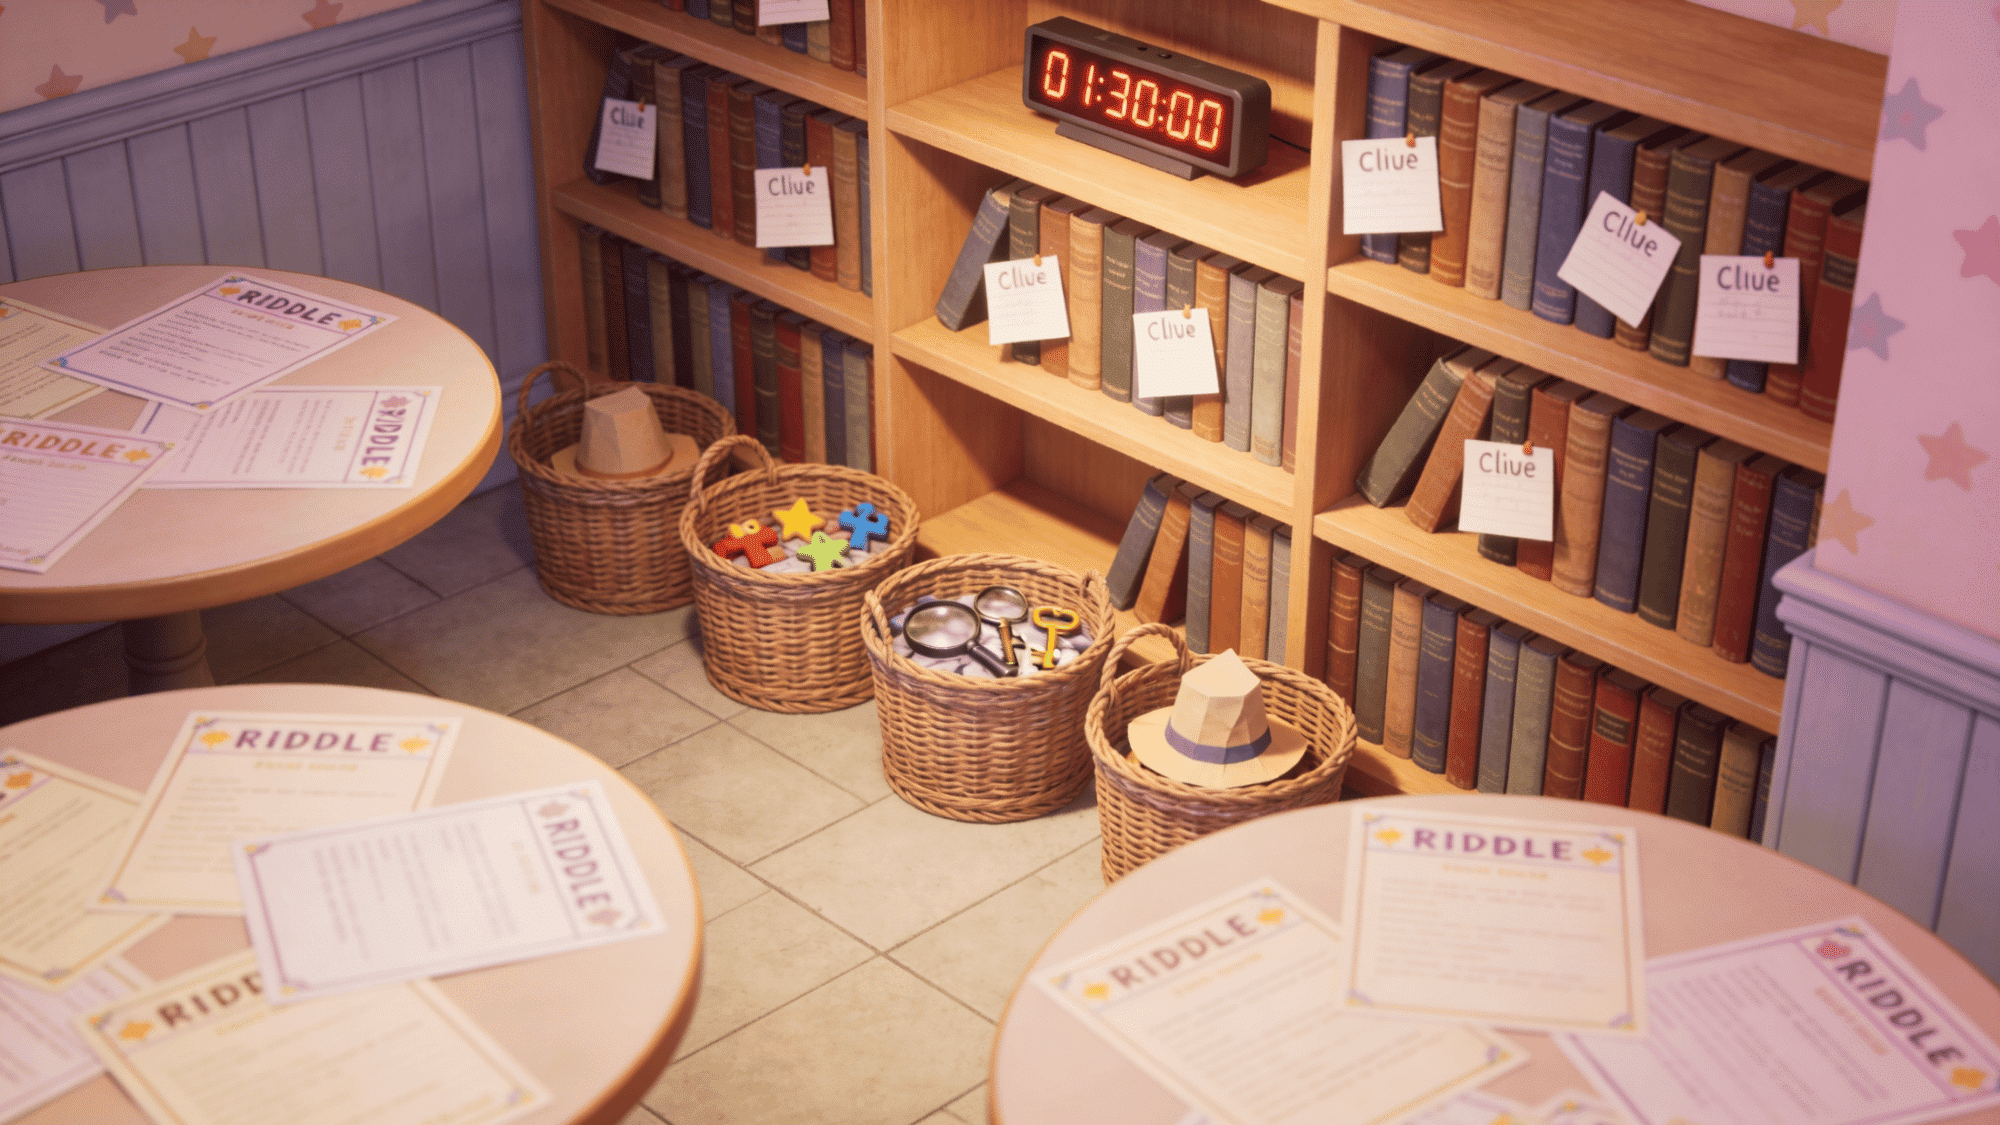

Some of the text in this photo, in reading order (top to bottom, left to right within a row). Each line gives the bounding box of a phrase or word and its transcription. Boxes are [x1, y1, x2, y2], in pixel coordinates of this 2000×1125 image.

[1043, 50, 1223, 150] 01:30:00
[237, 289, 342, 325] RIDDLE
[1, 430, 126, 459] RIDDLE
[361, 407, 408, 467] RIDDLE
[234, 729, 394, 752] RIDDLE
[543, 818, 613, 910] RIDDLE
[1413, 827, 1574, 862] RIDDLE
[1108, 914, 1258, 989] RIDDLE
[157, 970, 263, 1029] RIDD
[1836, 960, 1967, 1069] RIDDLE
